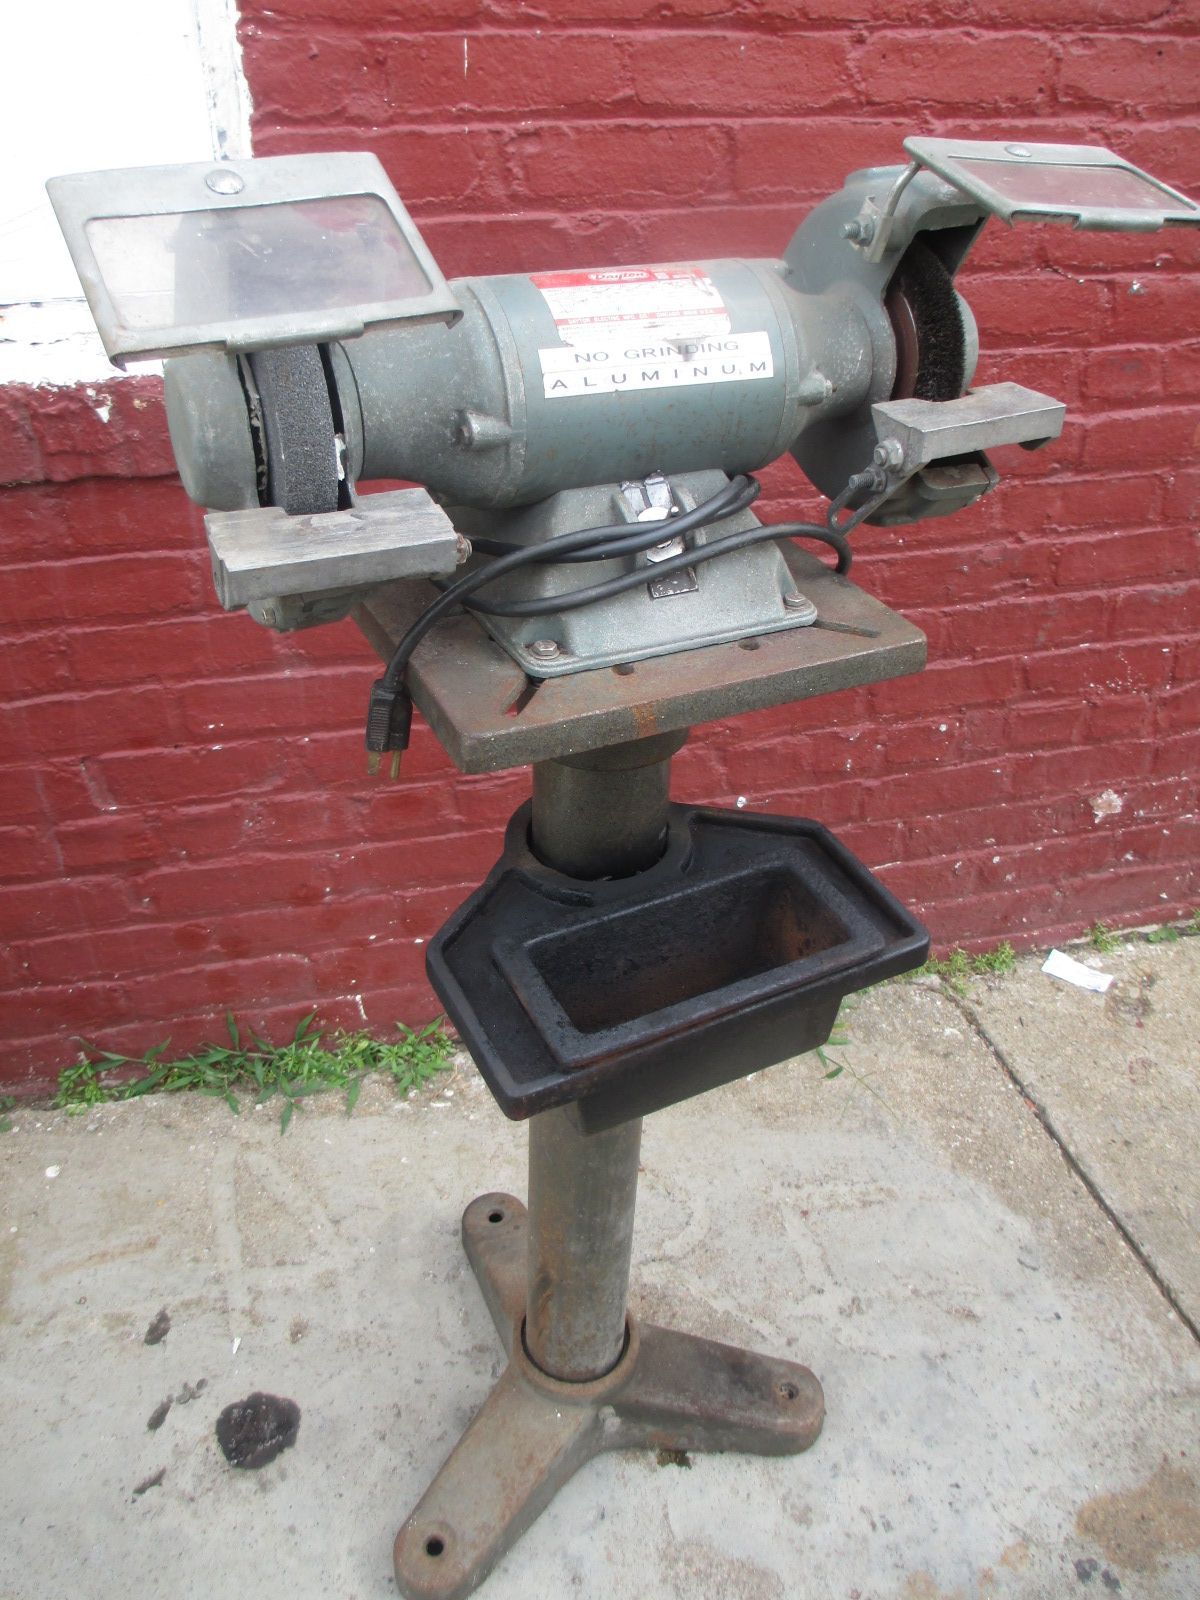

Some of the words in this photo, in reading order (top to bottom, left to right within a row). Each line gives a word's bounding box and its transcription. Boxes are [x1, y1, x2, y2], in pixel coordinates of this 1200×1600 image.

[594, 271, 645, 281] Dayton
[574, 351, 609, 363] NO
[624, 341, 739, 359] GRINDING
